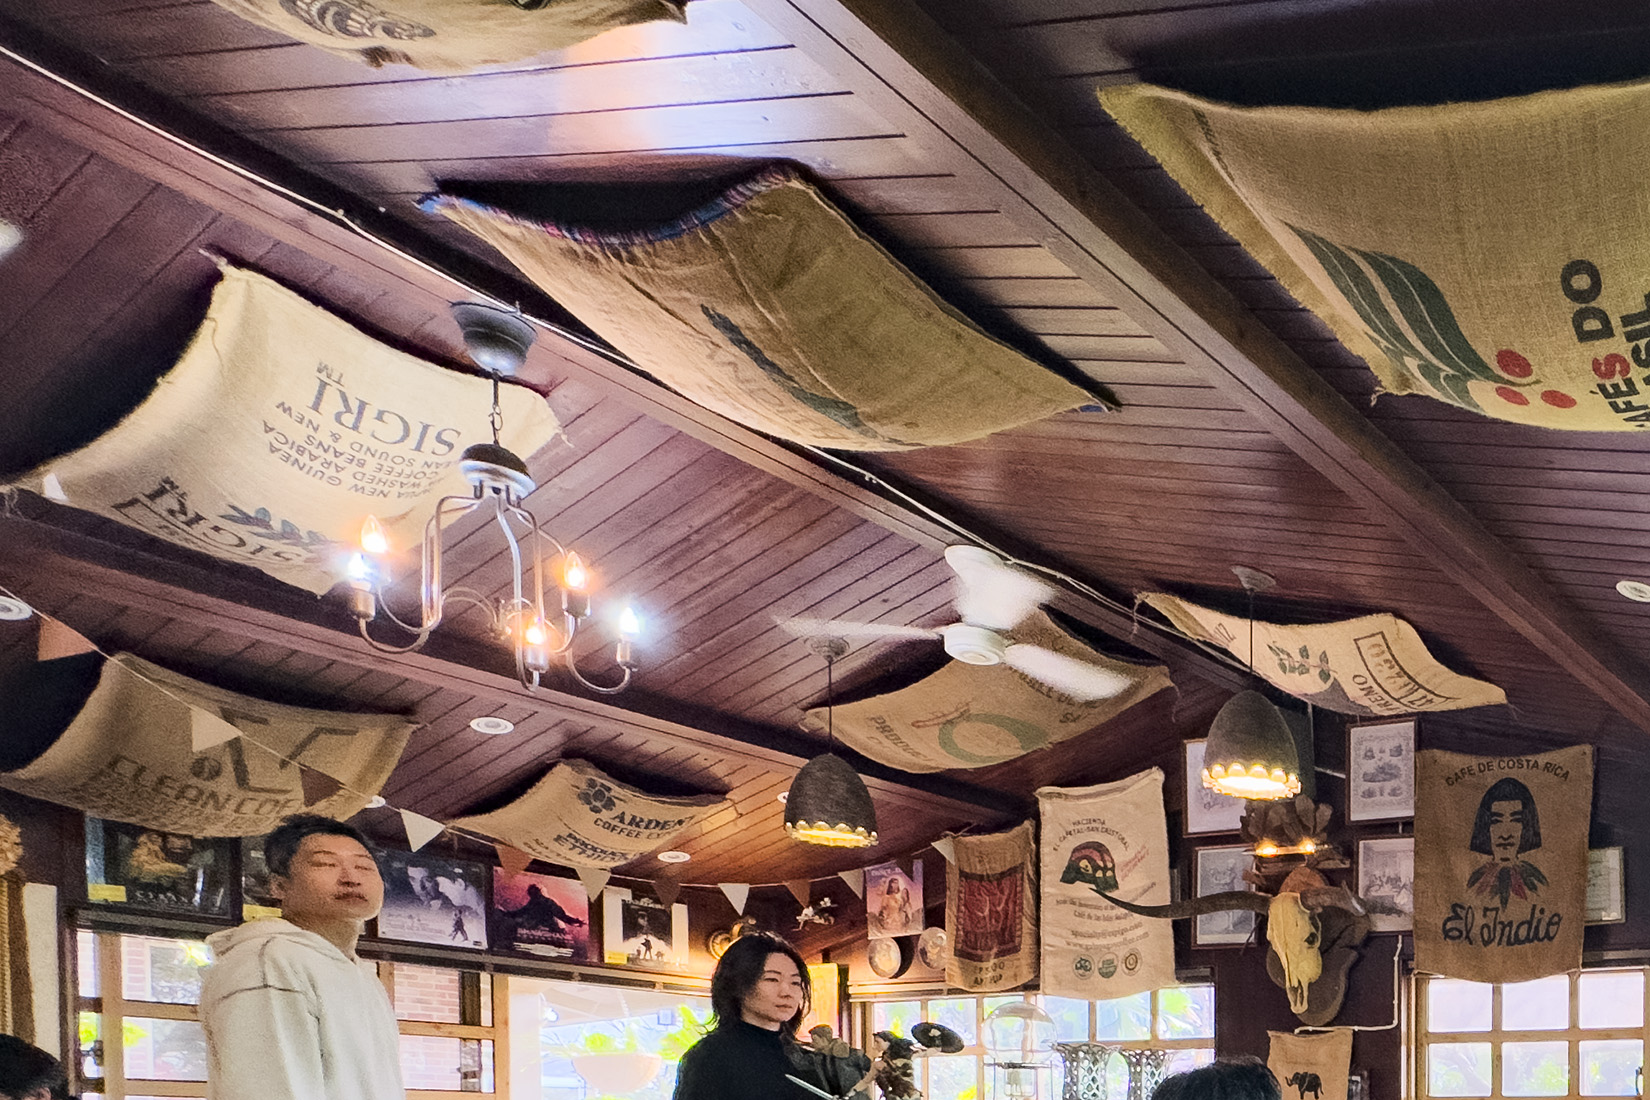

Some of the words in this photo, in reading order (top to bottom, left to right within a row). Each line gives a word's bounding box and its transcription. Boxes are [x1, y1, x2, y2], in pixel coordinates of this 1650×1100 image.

[1560, 258, 1616, 344] DO
[316, 361, 344, 388] TM
[274, 400, 321, 430] NEW
[306, 377, 461, 456] SIGRI
[262, 420, 345, 474] ARABICA
[328, 429, 342, 442] &
[266, 441, 343, 488] GUINEA
[304, 433, 367, 469] BEANS
[350, 441, 415, 467] SOUND
[349, 460, 421, 493] WASHED
[372, 458, 438, 481] COFFEE
[347, 484, 390, 500] NEW
[1445, 765, 1477, 788] CAFE
[1477, 760, 1495, 774] DE
[1497, 758, 1540, 770] COSTA
[1542, 761, 1571, 782] RICA
[594, 817, 643, 839] COFFEE
[1442, 902, 1475, 946] El
[1480, 904, 1563, 948] Indio
